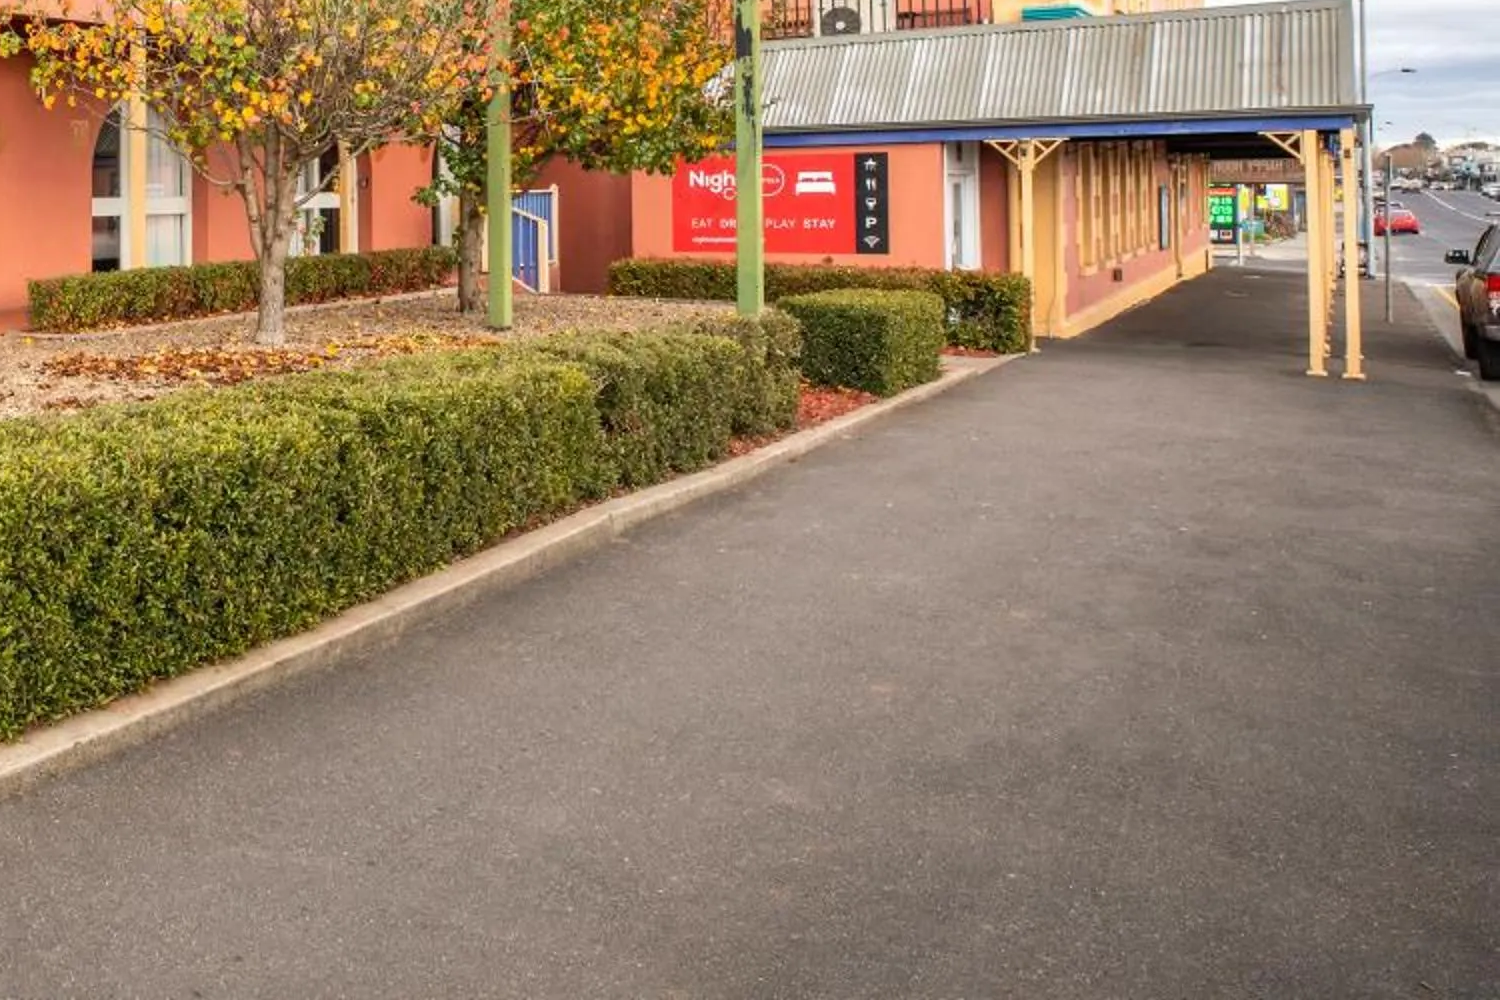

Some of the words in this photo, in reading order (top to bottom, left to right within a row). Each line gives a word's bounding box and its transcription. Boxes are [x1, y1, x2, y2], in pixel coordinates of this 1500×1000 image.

[689, 169, 737, 193] Nigh
[691, 217, 713, 229] EAT
[765, 217, 797, 229] PLAY
[803, 217, 837, 230] STAY
